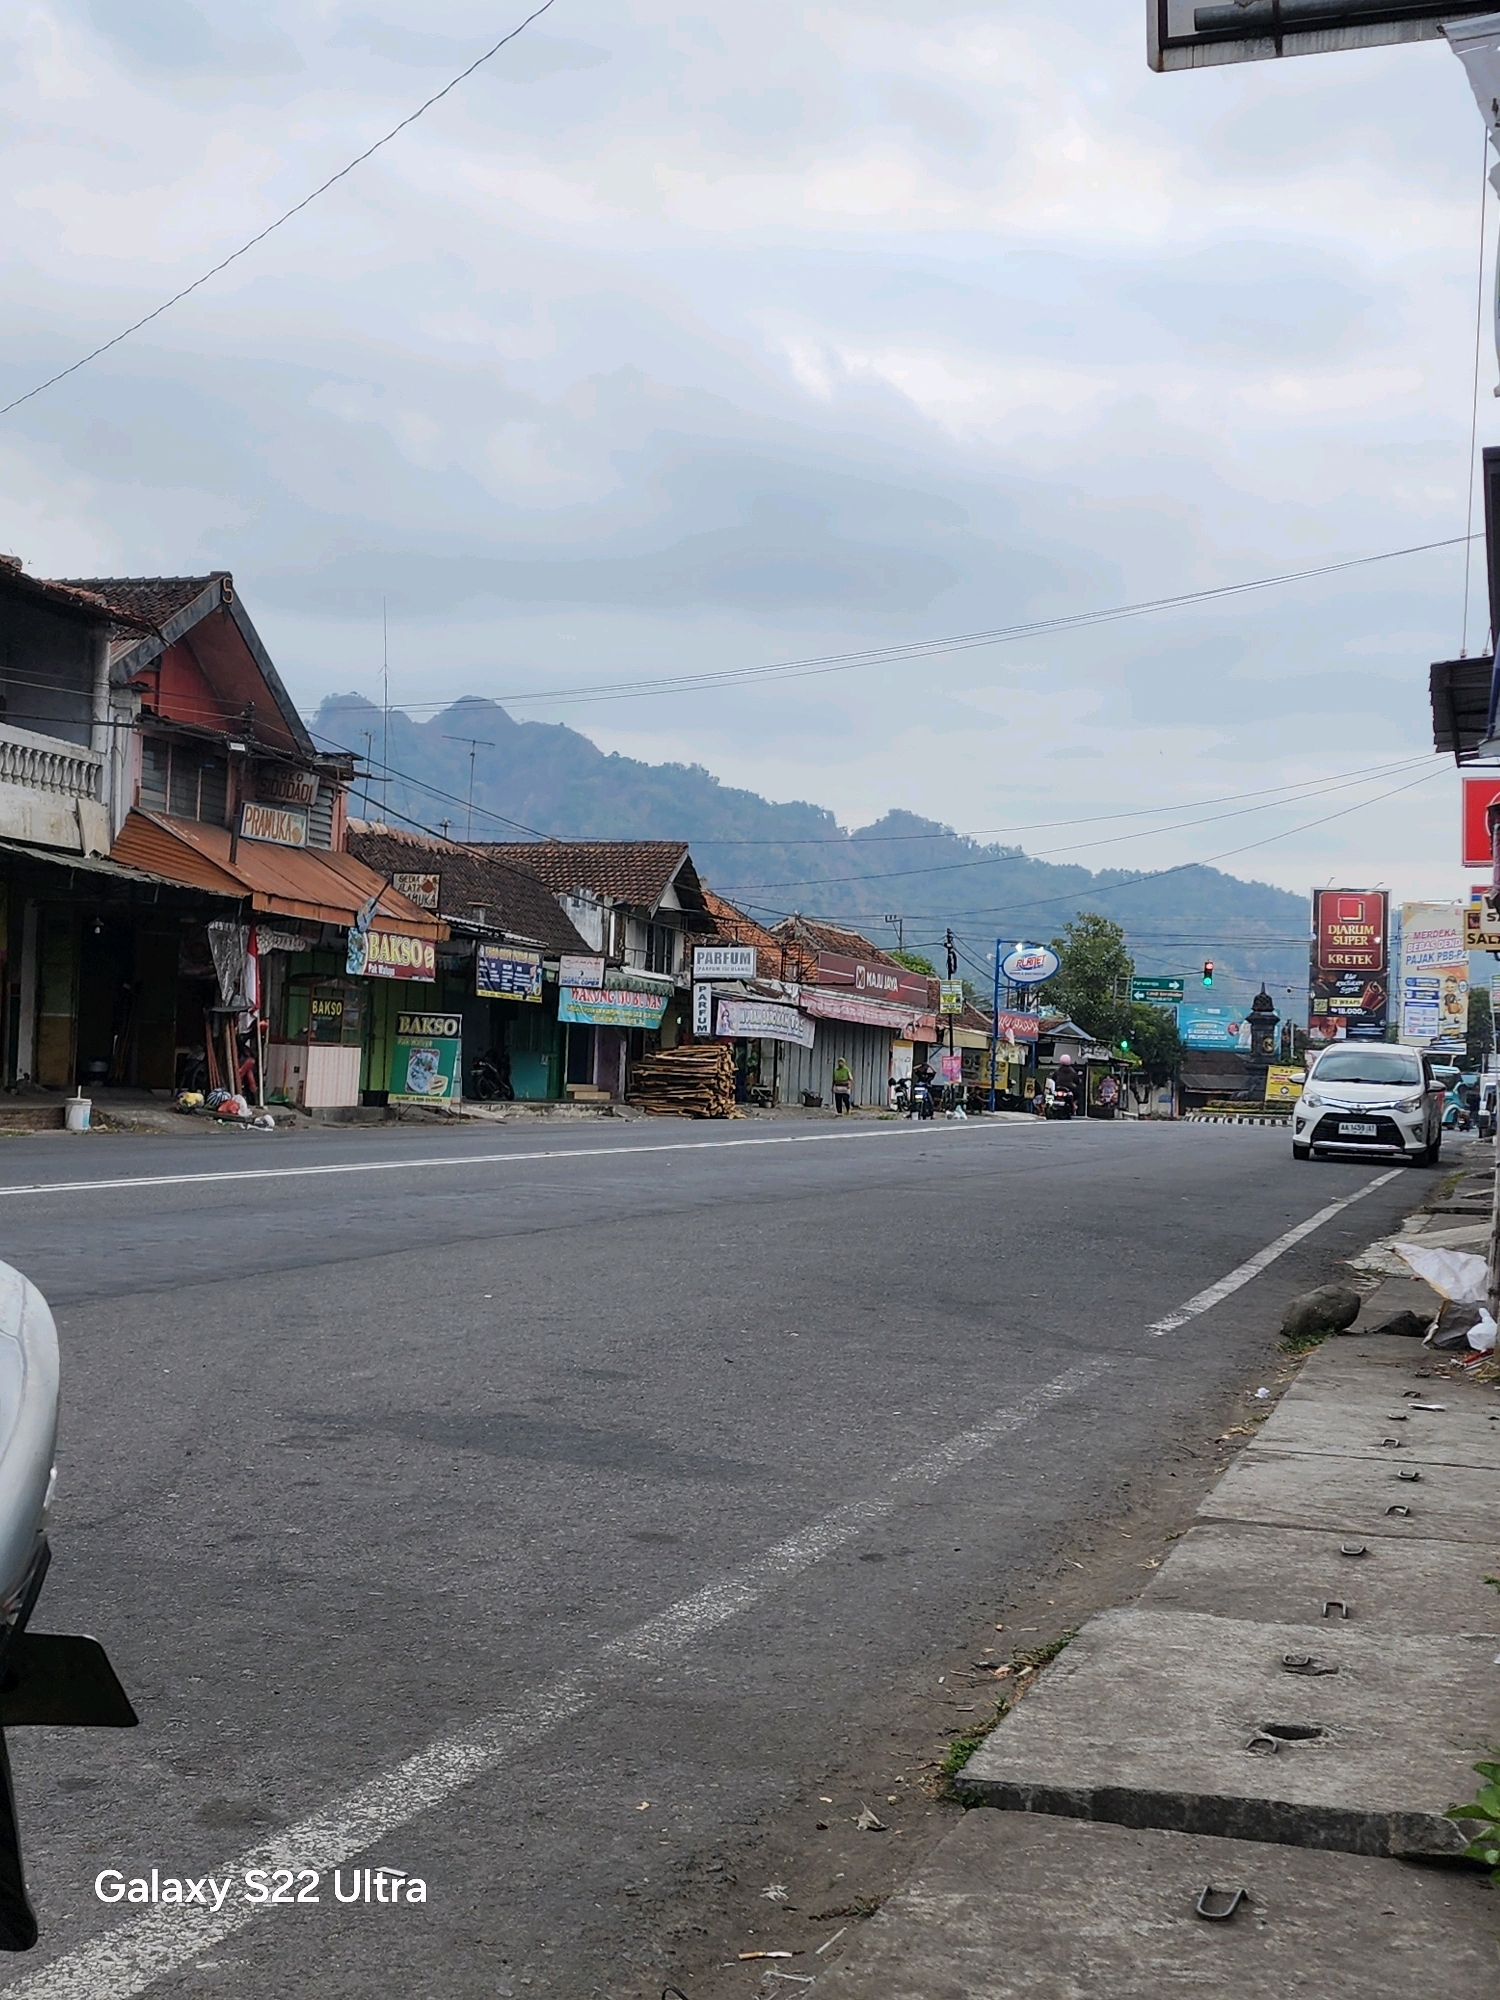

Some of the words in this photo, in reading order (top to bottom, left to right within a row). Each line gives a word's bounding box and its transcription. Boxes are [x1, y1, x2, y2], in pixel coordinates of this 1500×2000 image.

[275, 769, 304, 783] TOKO
[243, 805, 292, 842] PRAMUKA
[1327, 924, 1374, 936] DJARUM
[1413, 928, 1457, 940] MERDEKA
[1332, 935, 1369, 946] SUPER
[1406, 941, 1437, 953] BEBAS
[1437, 938, 1464, 950] DEND
[367, 931, 423, 968] BAKSO
[696, 952, 751, 965] PARFUM
[1328, 953, 1373, 965] KRETEK
[1405, 952, 1436, 966] PAJAK
[368, 963, 378, 974] Pak
[883, 974, 899, 992] JAYA
[312, 1000, 343, 1016] BAKSO
[696, 985, 708, 1032] PARFUM
[398, 1016, 458, 1036] BAKSO
